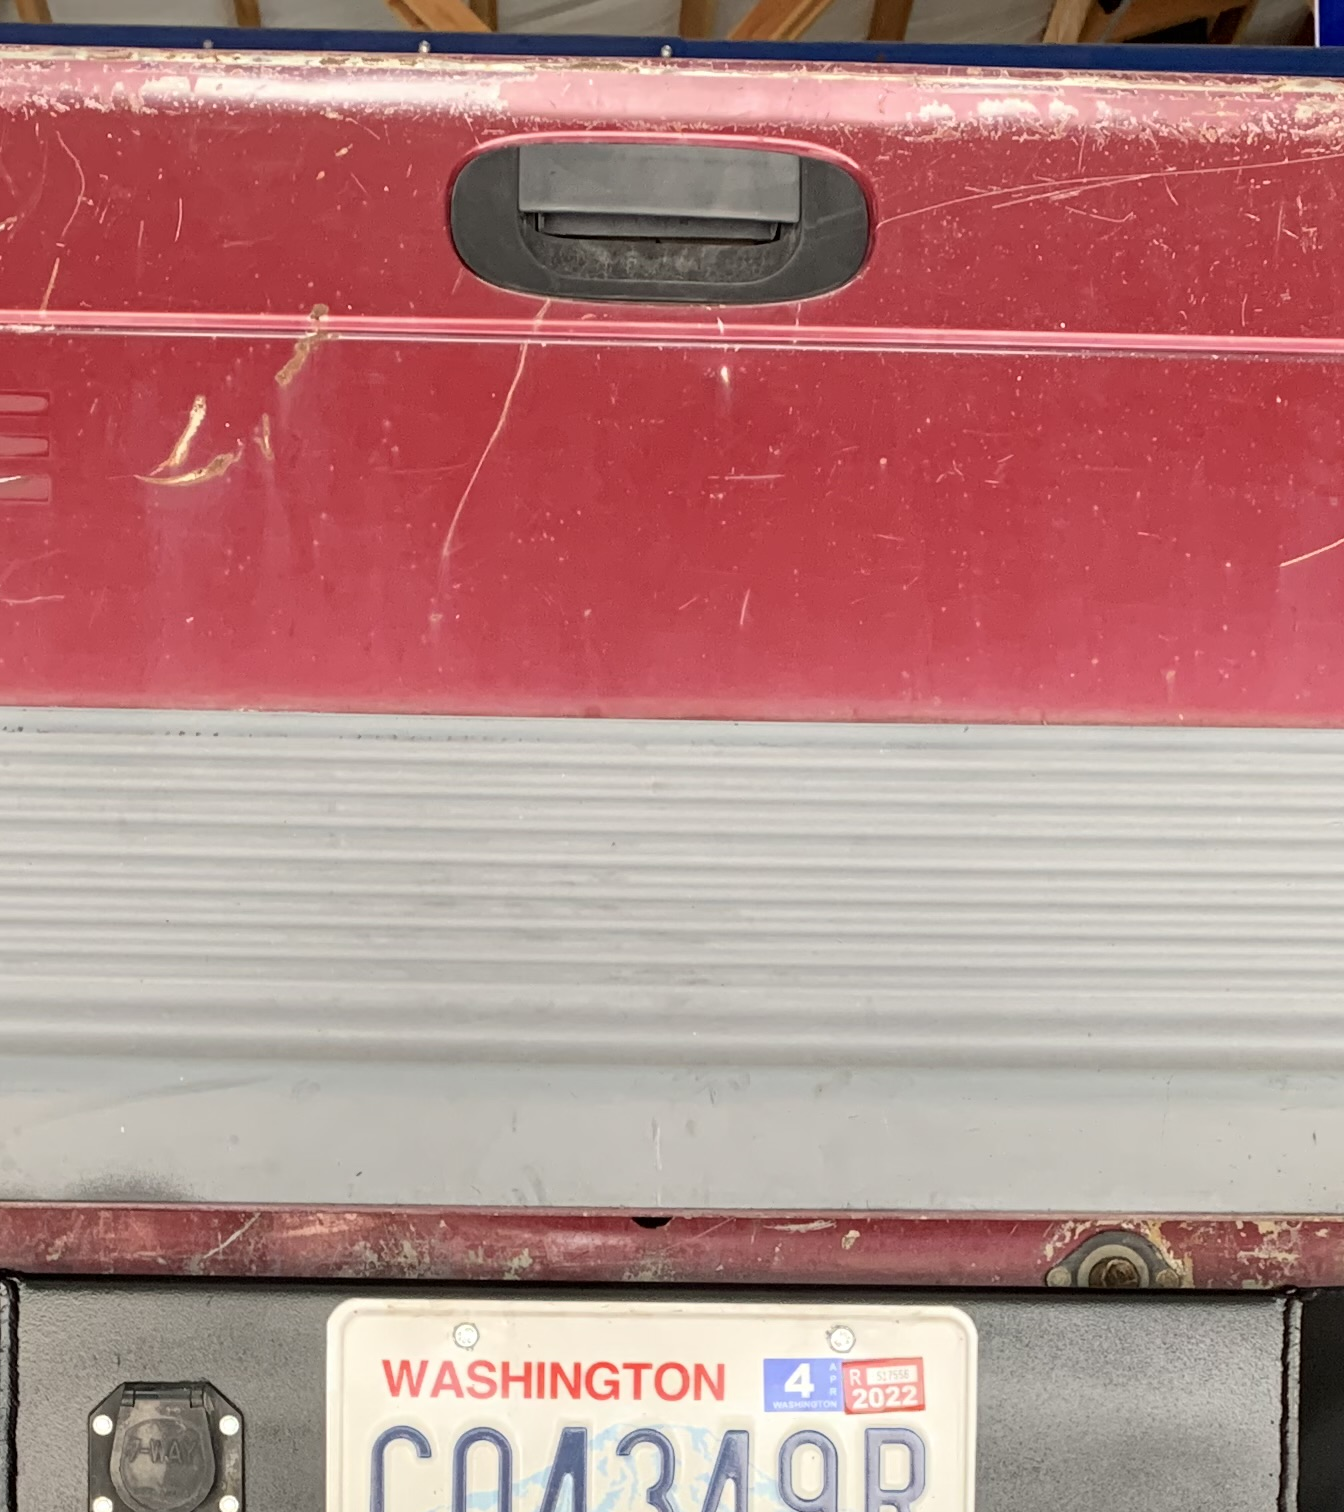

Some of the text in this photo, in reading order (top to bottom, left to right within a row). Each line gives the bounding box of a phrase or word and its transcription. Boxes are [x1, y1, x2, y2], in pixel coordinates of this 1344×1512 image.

[381, 1359, 726, 1401] WASHINGTON
[784, 1363, 815, 1398] 4
[772, 1400, 838, 1410] WASHINGTON
[851, 1385, 919, 1410] 2022
[125, 1436, 198, 1465] 7-WAY
